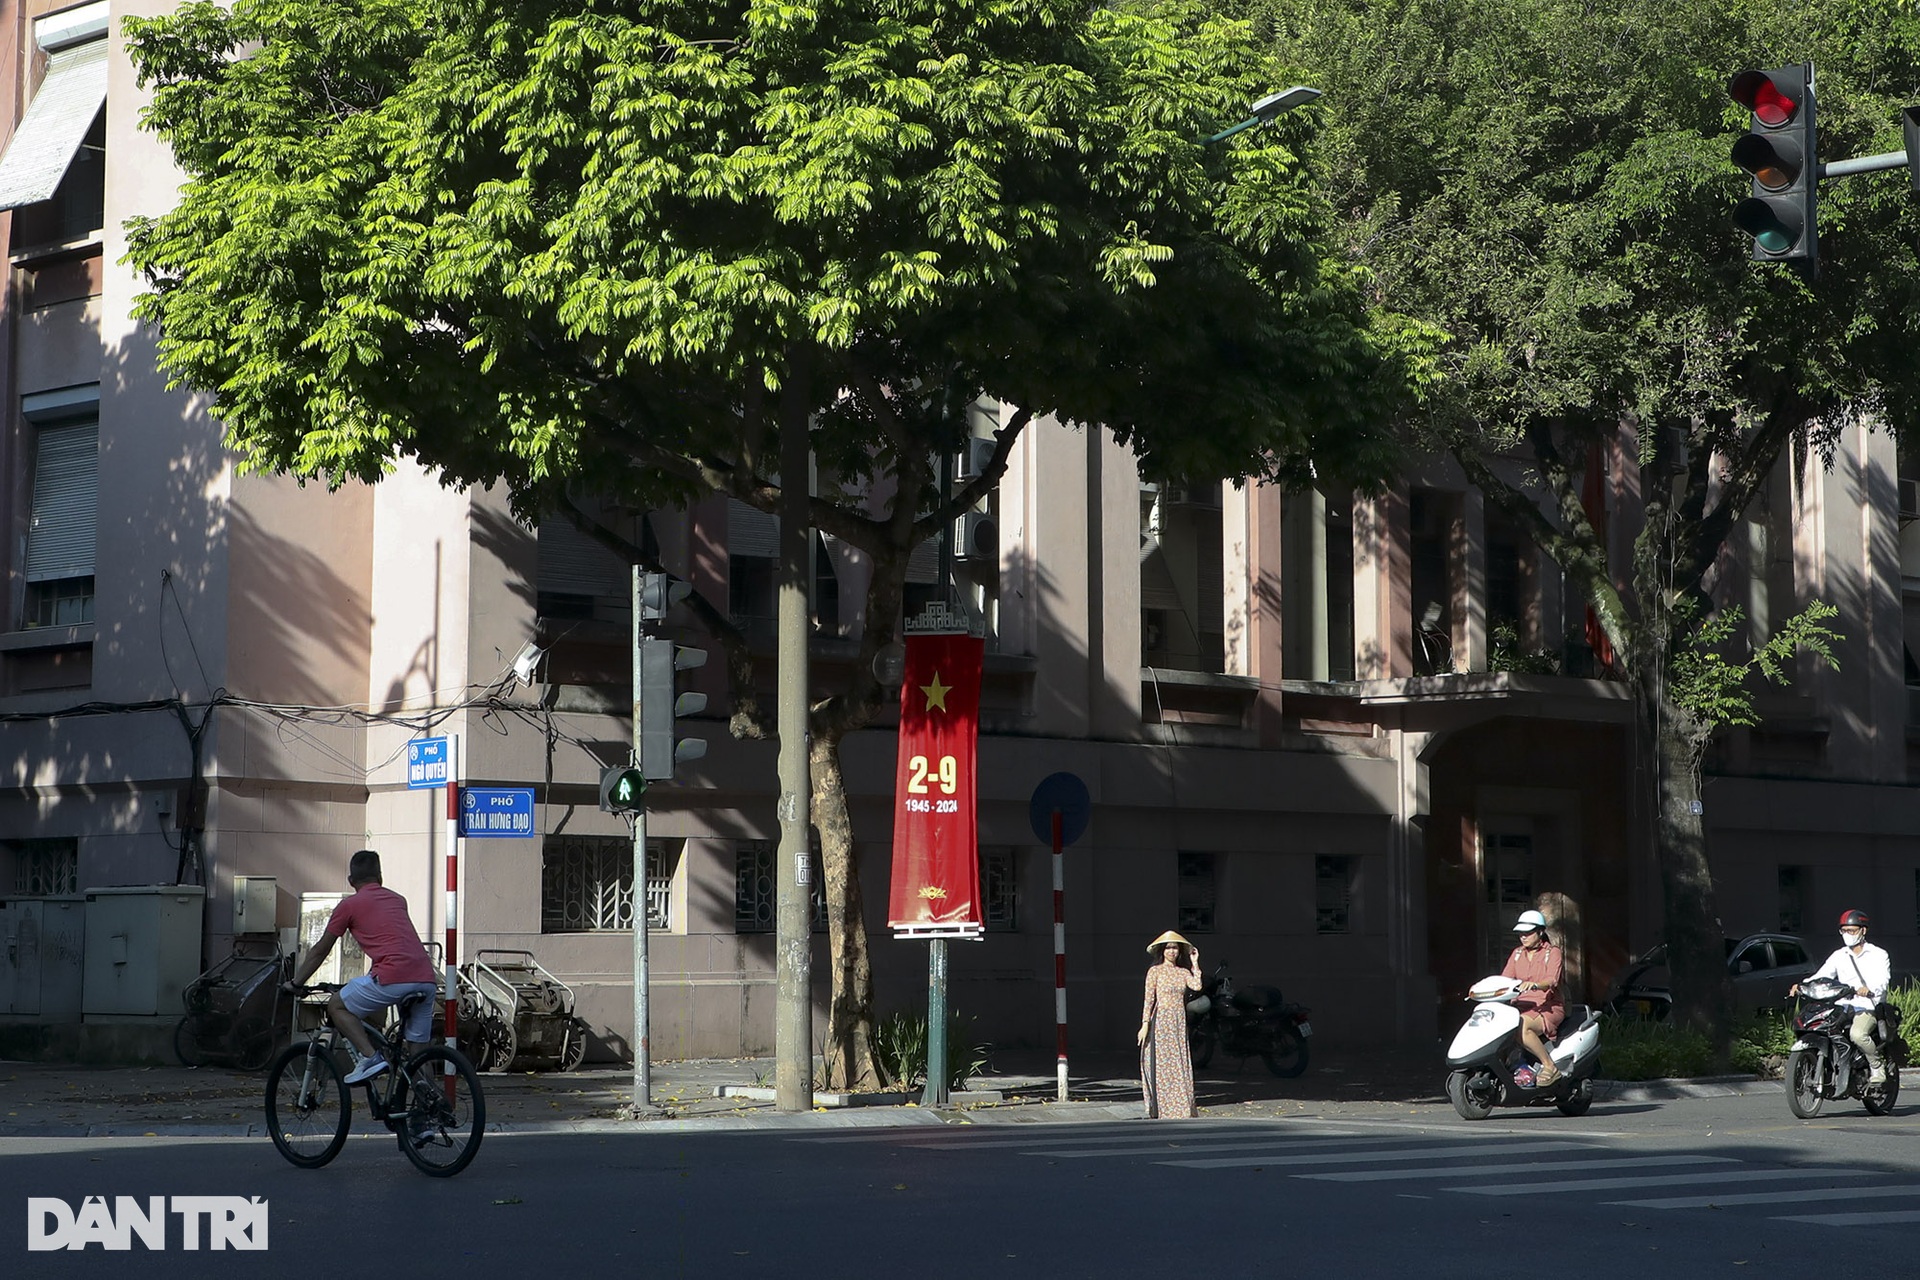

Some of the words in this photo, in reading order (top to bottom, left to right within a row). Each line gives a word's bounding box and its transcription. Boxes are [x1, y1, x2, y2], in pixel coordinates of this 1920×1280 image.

[424, 742, 438, 755] PHỐ
[908, 755, 956, 794] 2-9
[490, 794, 514, 806] PHỐ
[488, 811, 511, 830] HƯNG
[513, 812, 529, 832] ĐẠO
